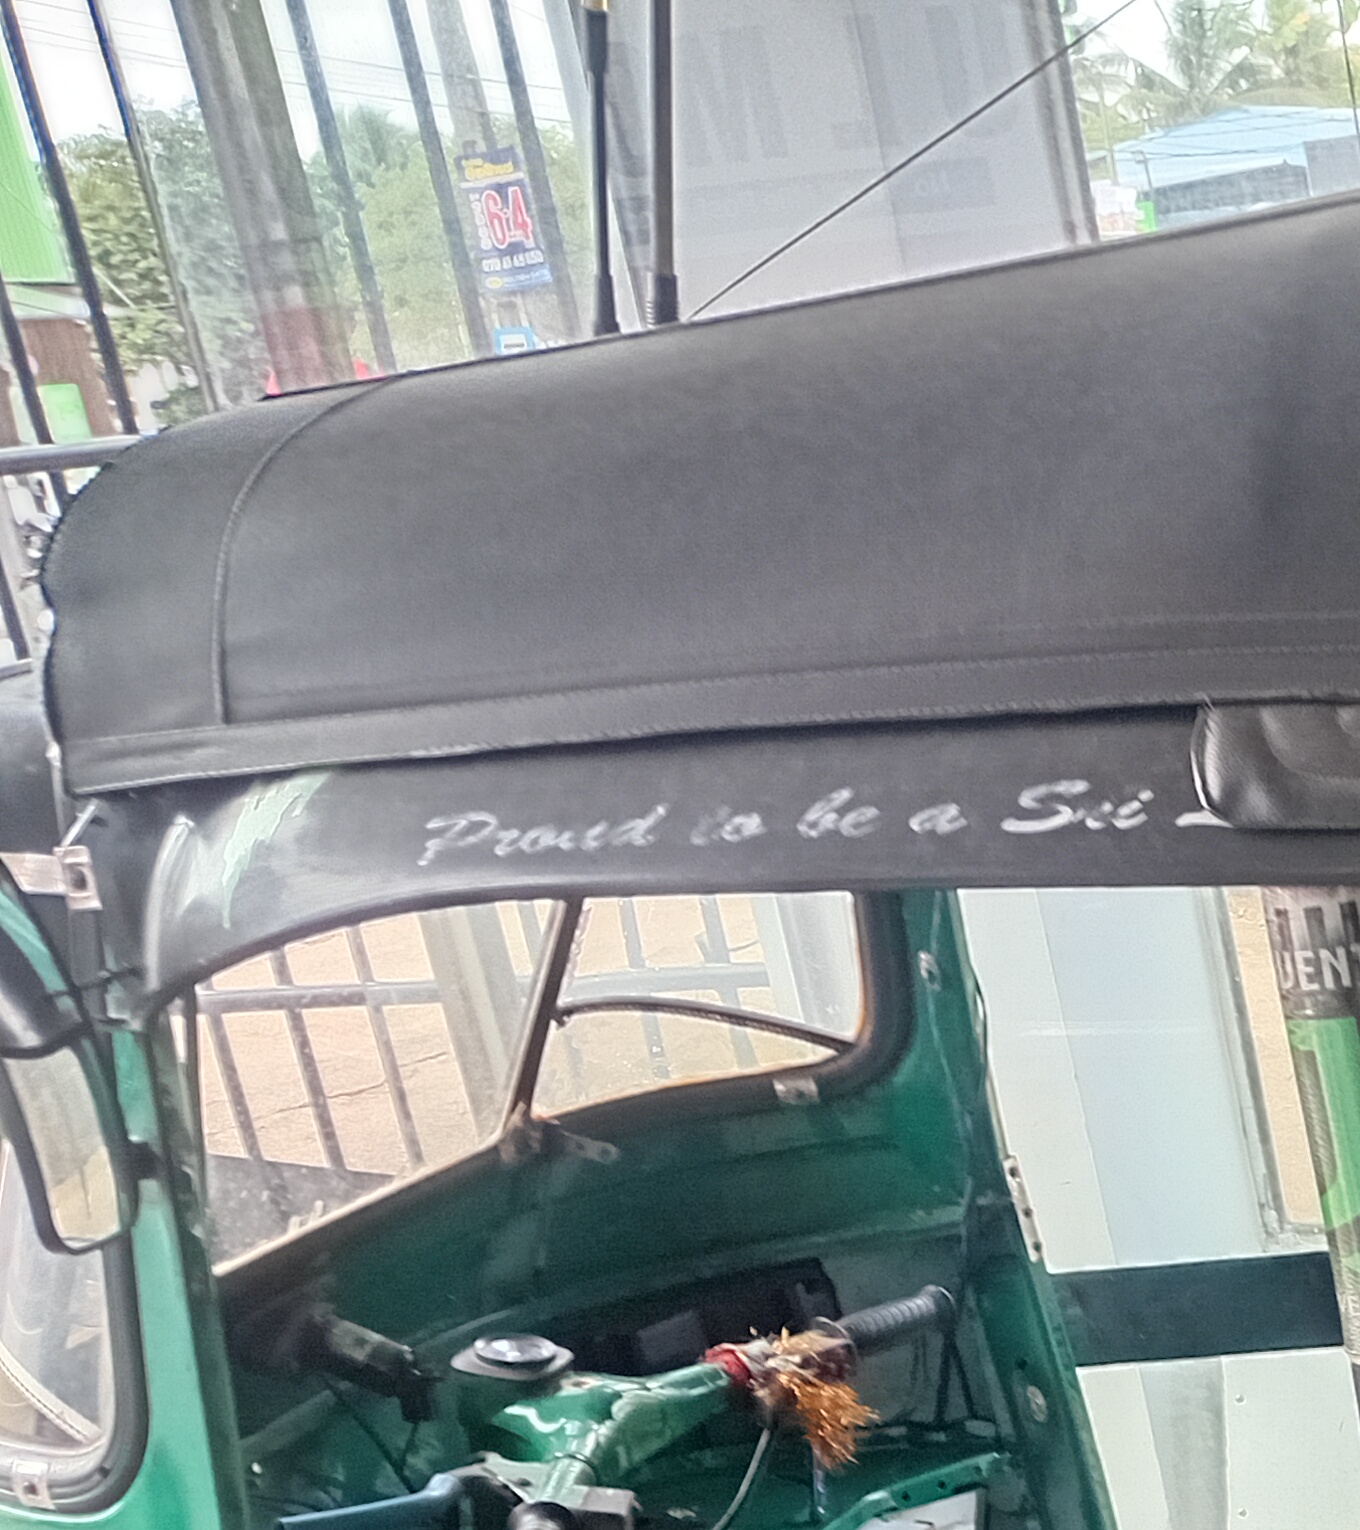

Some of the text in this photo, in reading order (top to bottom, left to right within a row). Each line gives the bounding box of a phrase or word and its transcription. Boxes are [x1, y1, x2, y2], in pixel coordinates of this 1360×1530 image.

[416, 803, 670, 867] Proud
[691, 804, 768, 848] to
[797, 787, 881, 837] be
[908, 801, 969, 836] a
